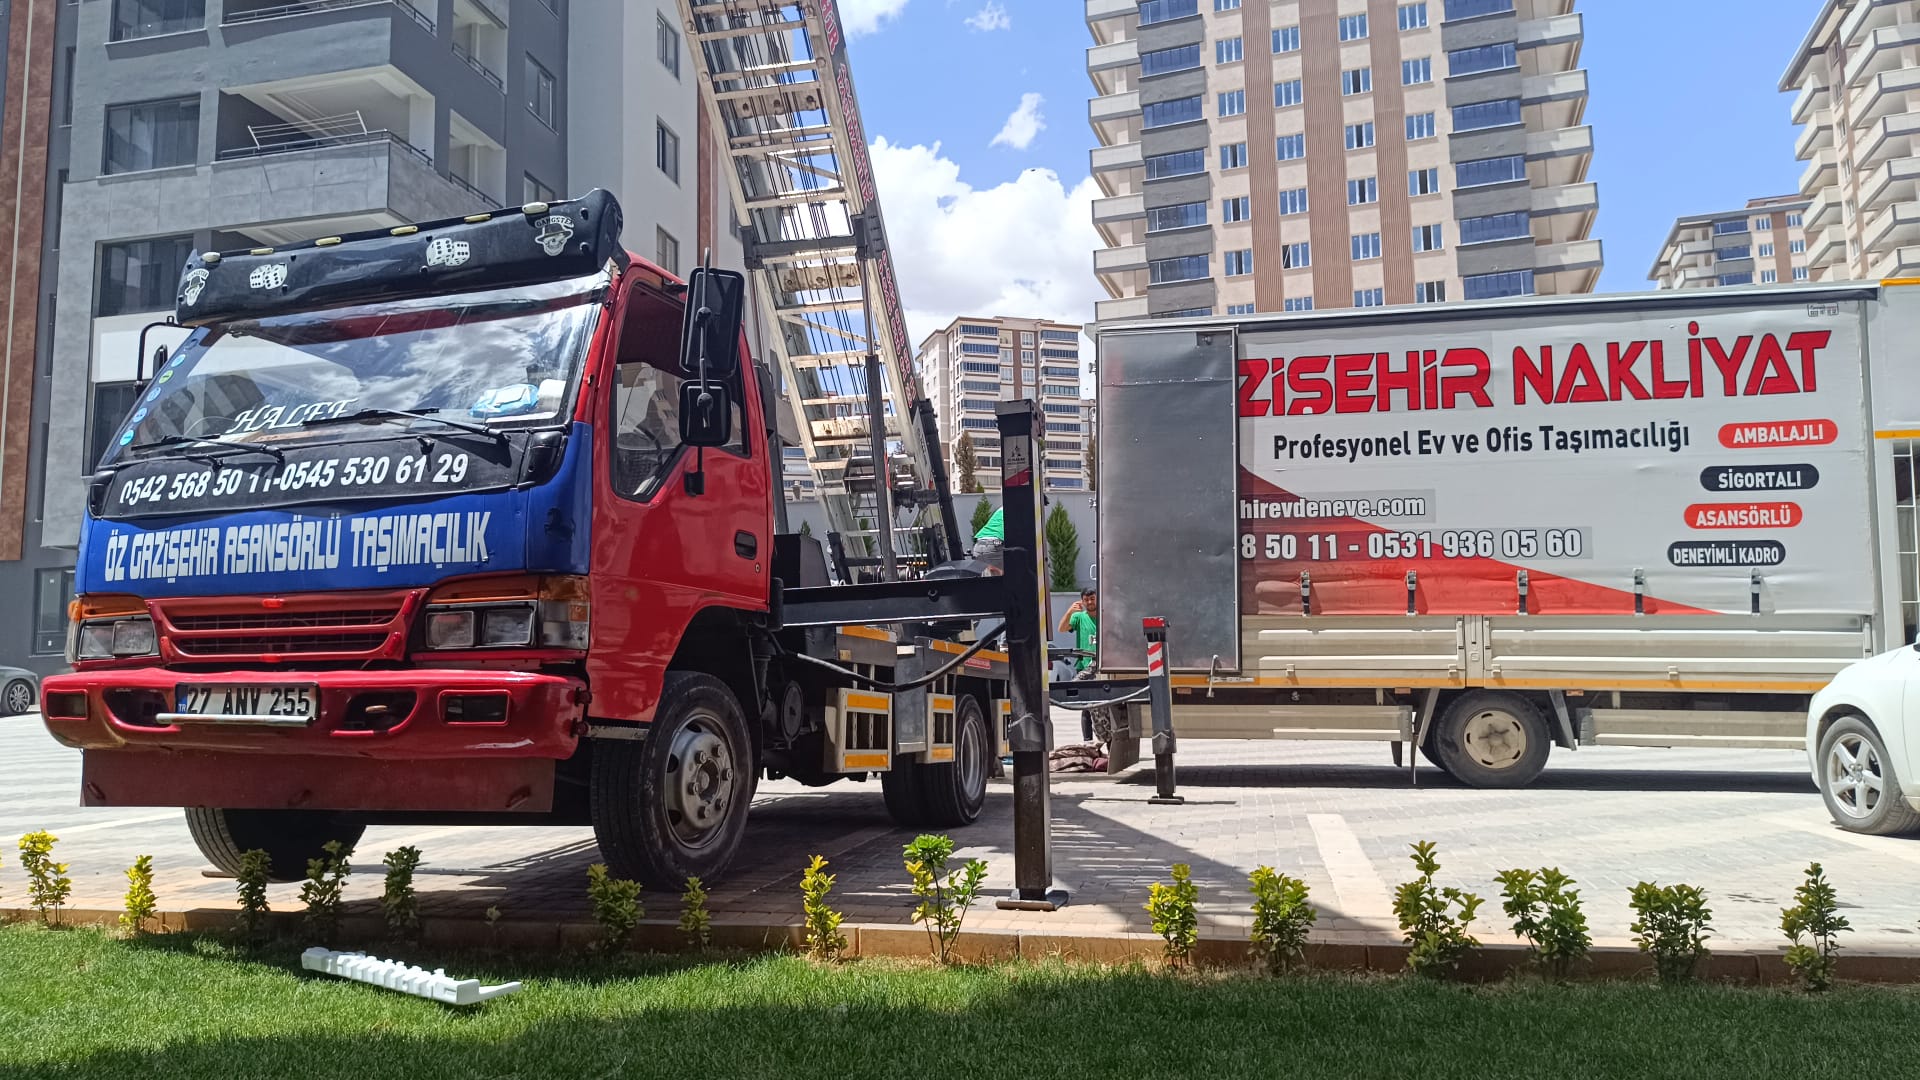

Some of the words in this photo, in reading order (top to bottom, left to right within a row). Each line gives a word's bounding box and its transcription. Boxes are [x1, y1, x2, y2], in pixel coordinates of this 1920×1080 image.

[1512, 320, 1832, 405] NAKLİYAT
[1273, 430, 1412, 464] Profesyonel
[1417, 429, 1447, 456] Ev
[1451, 433, 1480, 454] ve
[1485, 425, 1534, 453] Ofis
[1733, 423, 1825, 444] AMBALAJLI
[119, 474, 168, 506] 0542
[168, 470, 212, 501] 568
[212, 468, 244, 497] 50
[340, 456, 391, 487] 530
[395, 454, 427, 484] 61
[432, 453, 469, 483] 29
[1718, 468, 1802, 489] SİGORTALI
[1239, 496, 1426, 520] hirevdeneve.com
[1695, 504, 1792, 527] ASANSÖRLÜ
[104, 528, 129, 582] ÖZ
[223, 511, 342, 575] ASANSÖRLÜ
[1264, 533, 1298, 560] 50
[1307, 533, 1339, 561] 11
[1367, 531, 1433, 559] 0531
[1441, 530, 1495, 559] 936
[1501, 529, 1539, 559] 05
[1545, 528, 1583, 558] 60
[1673, 543, 1738, 564] DENEYİMLİ
[1738, 546, 1780, 564] KADRO
[178, 703, 187, 713] TR
[187, 687, 212, 715] 27
[222, 687, 262, 715] ANV
[269, 687, 311, 716] 255
